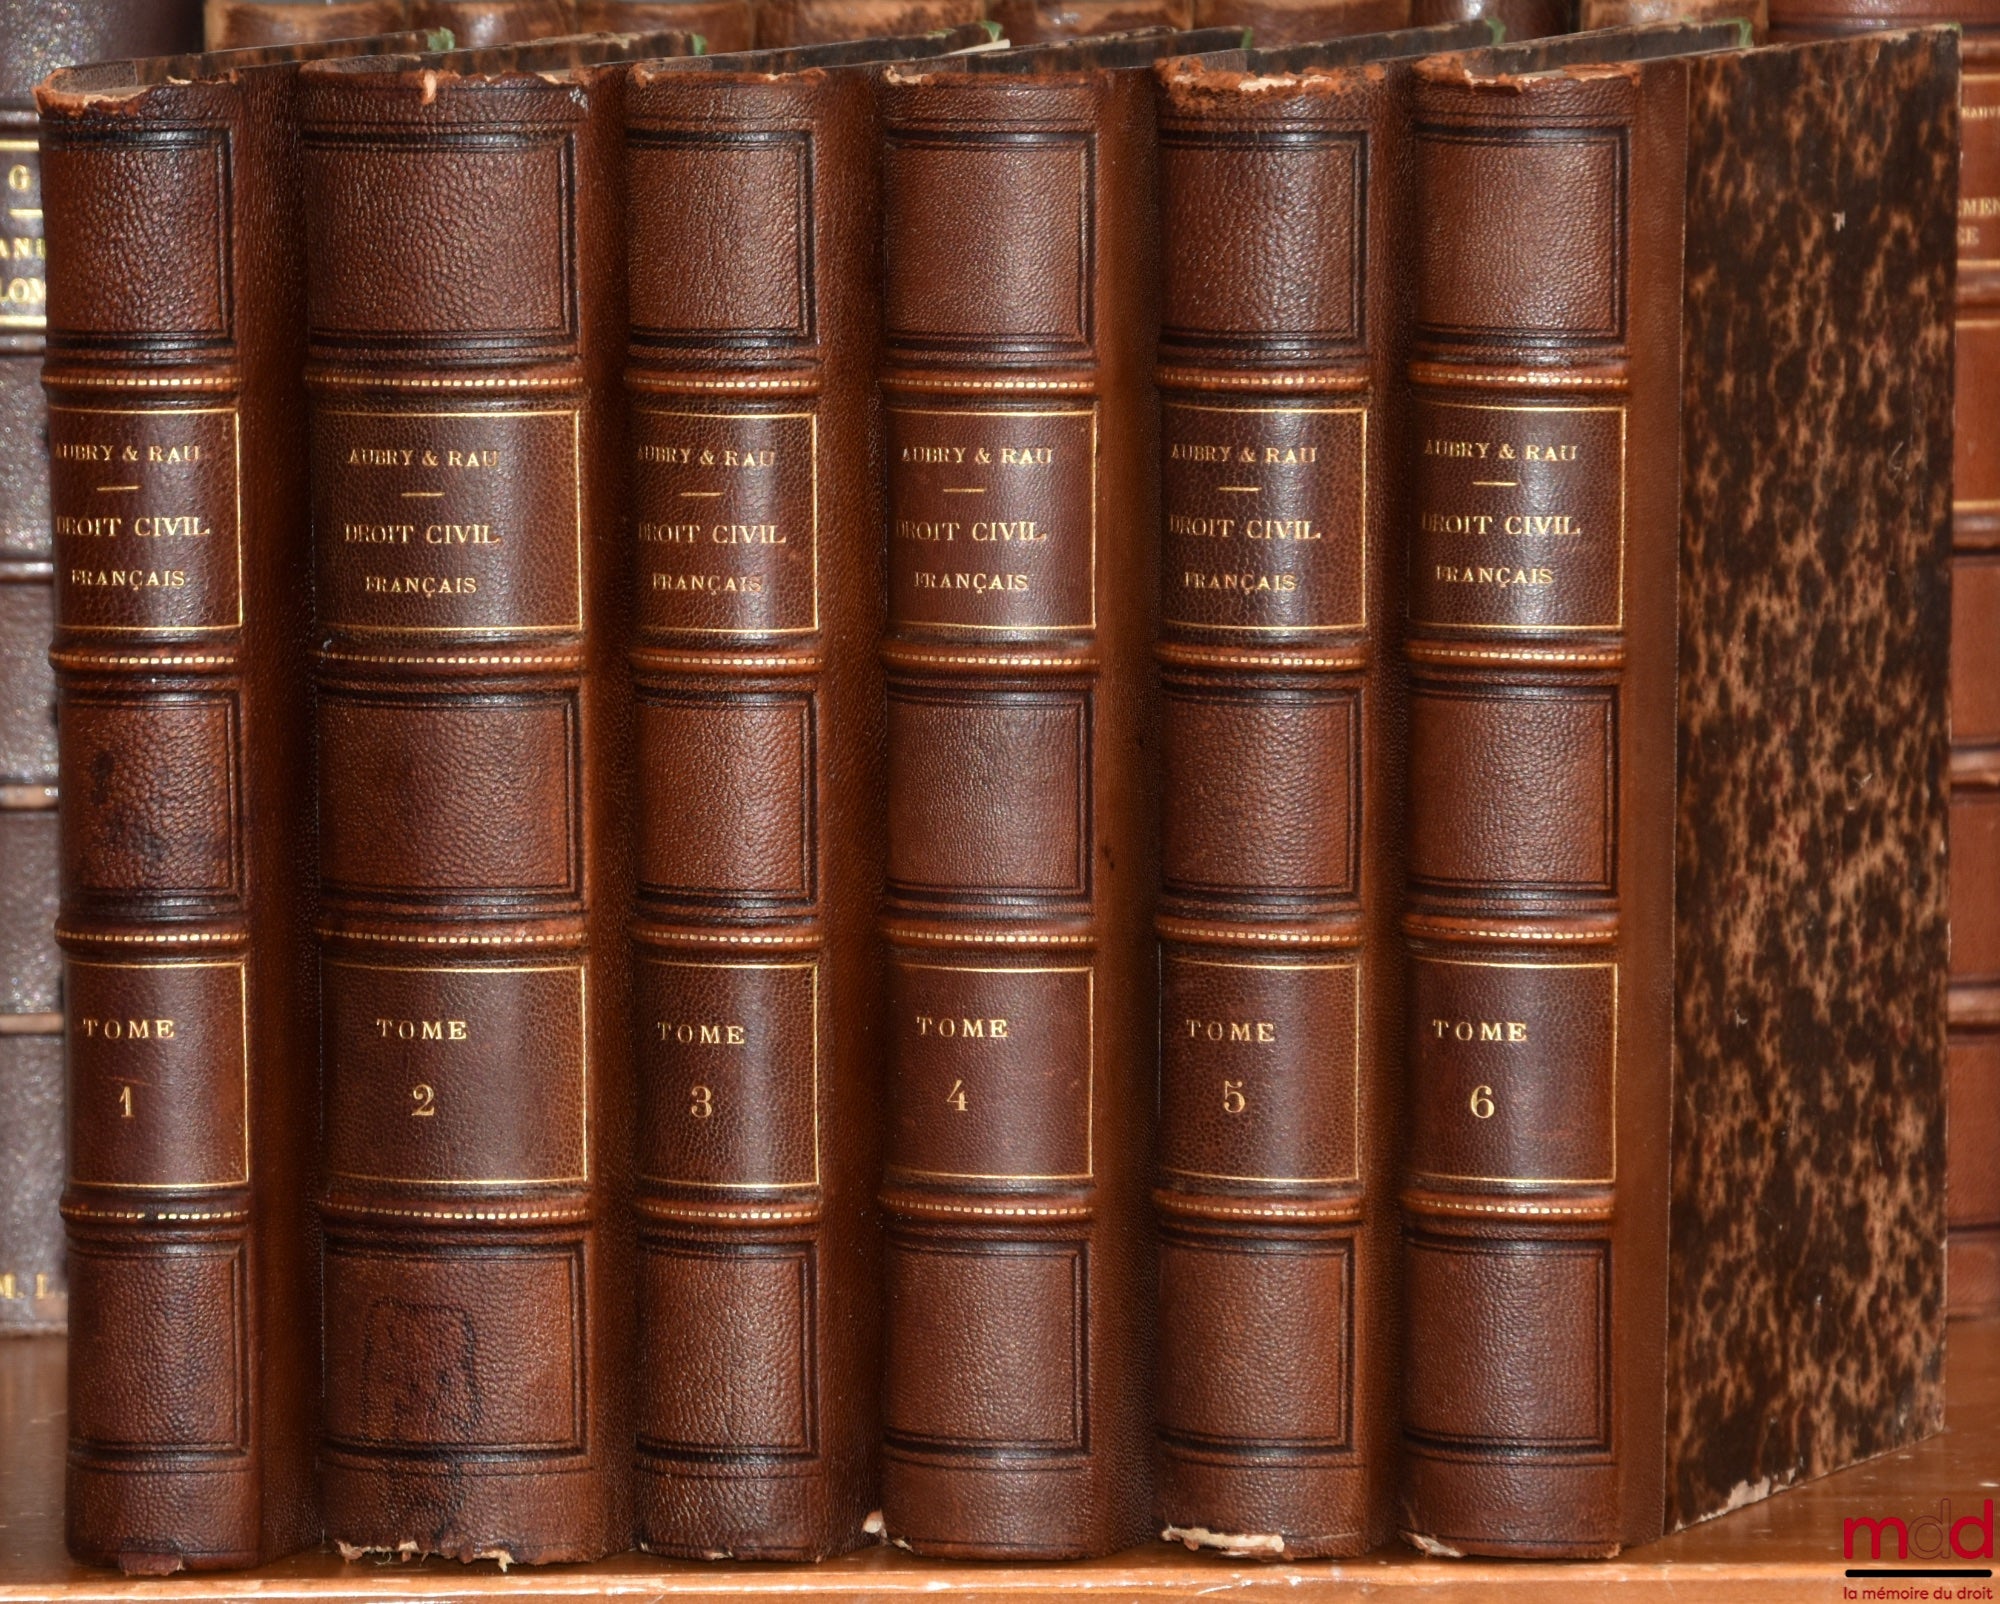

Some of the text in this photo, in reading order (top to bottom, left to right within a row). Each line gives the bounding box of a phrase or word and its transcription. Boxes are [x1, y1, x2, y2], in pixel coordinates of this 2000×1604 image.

[55, 443, 200, 464] AUBRY & RAU
[348, 449, 499, 467] AUBRY & RAU
[637, 445, 775, 466] AUBRY & RAU
[902, 447, 1053, 464] AUBRY & RAU
[1171, 444, 1317, 464] AUBRY & RAU
[1424, 440, 1578, 462] AUBRY & RAU
[56, 516, 210, 536] DROIT CIVIL
[344, 523, 501, 544] DROIT CIVIL
[638, 523, 786, 544] DROIT CIVIL
[896, 519, 1047, 541] DROIT CIVIL
[1169, 515, 1321, 539] DROIT CIVIL
[1422, 513, 1581, 534] DROIT CIVIL
[72, 569, 185, 590] FRANÇAIS
[365, 576, 477, 598] FRANÇAIS
[653, 573, 762, 595] FRANÇAIS
[914, 572, 1029, 594] FRANÇAIS
[1184, 572, 1296, 595] FRANÇAIS
[1437, 566, 1553, 587] FRANÇAIS
[83, 1018, 175, 1039] TOME
[376, 1019, 468, 1040] TOME
[658, 1022, 745, 1045] TOME
[916, 1016, 1009, 1038] TOME
[1186, 1019, 1275, 1042] TOME
[1432, 1019, 1527, 1042] TOME
[119, 1086, 135, 1118] 1
[411, 1083, 435, 1116] 2
[691, 1086, 712, 1118] 3
[947, 1080, 968, 1111] 4
[1223, 1080, 1245, 1113] 5
[1470, 1085, 1495, 1119] 6
